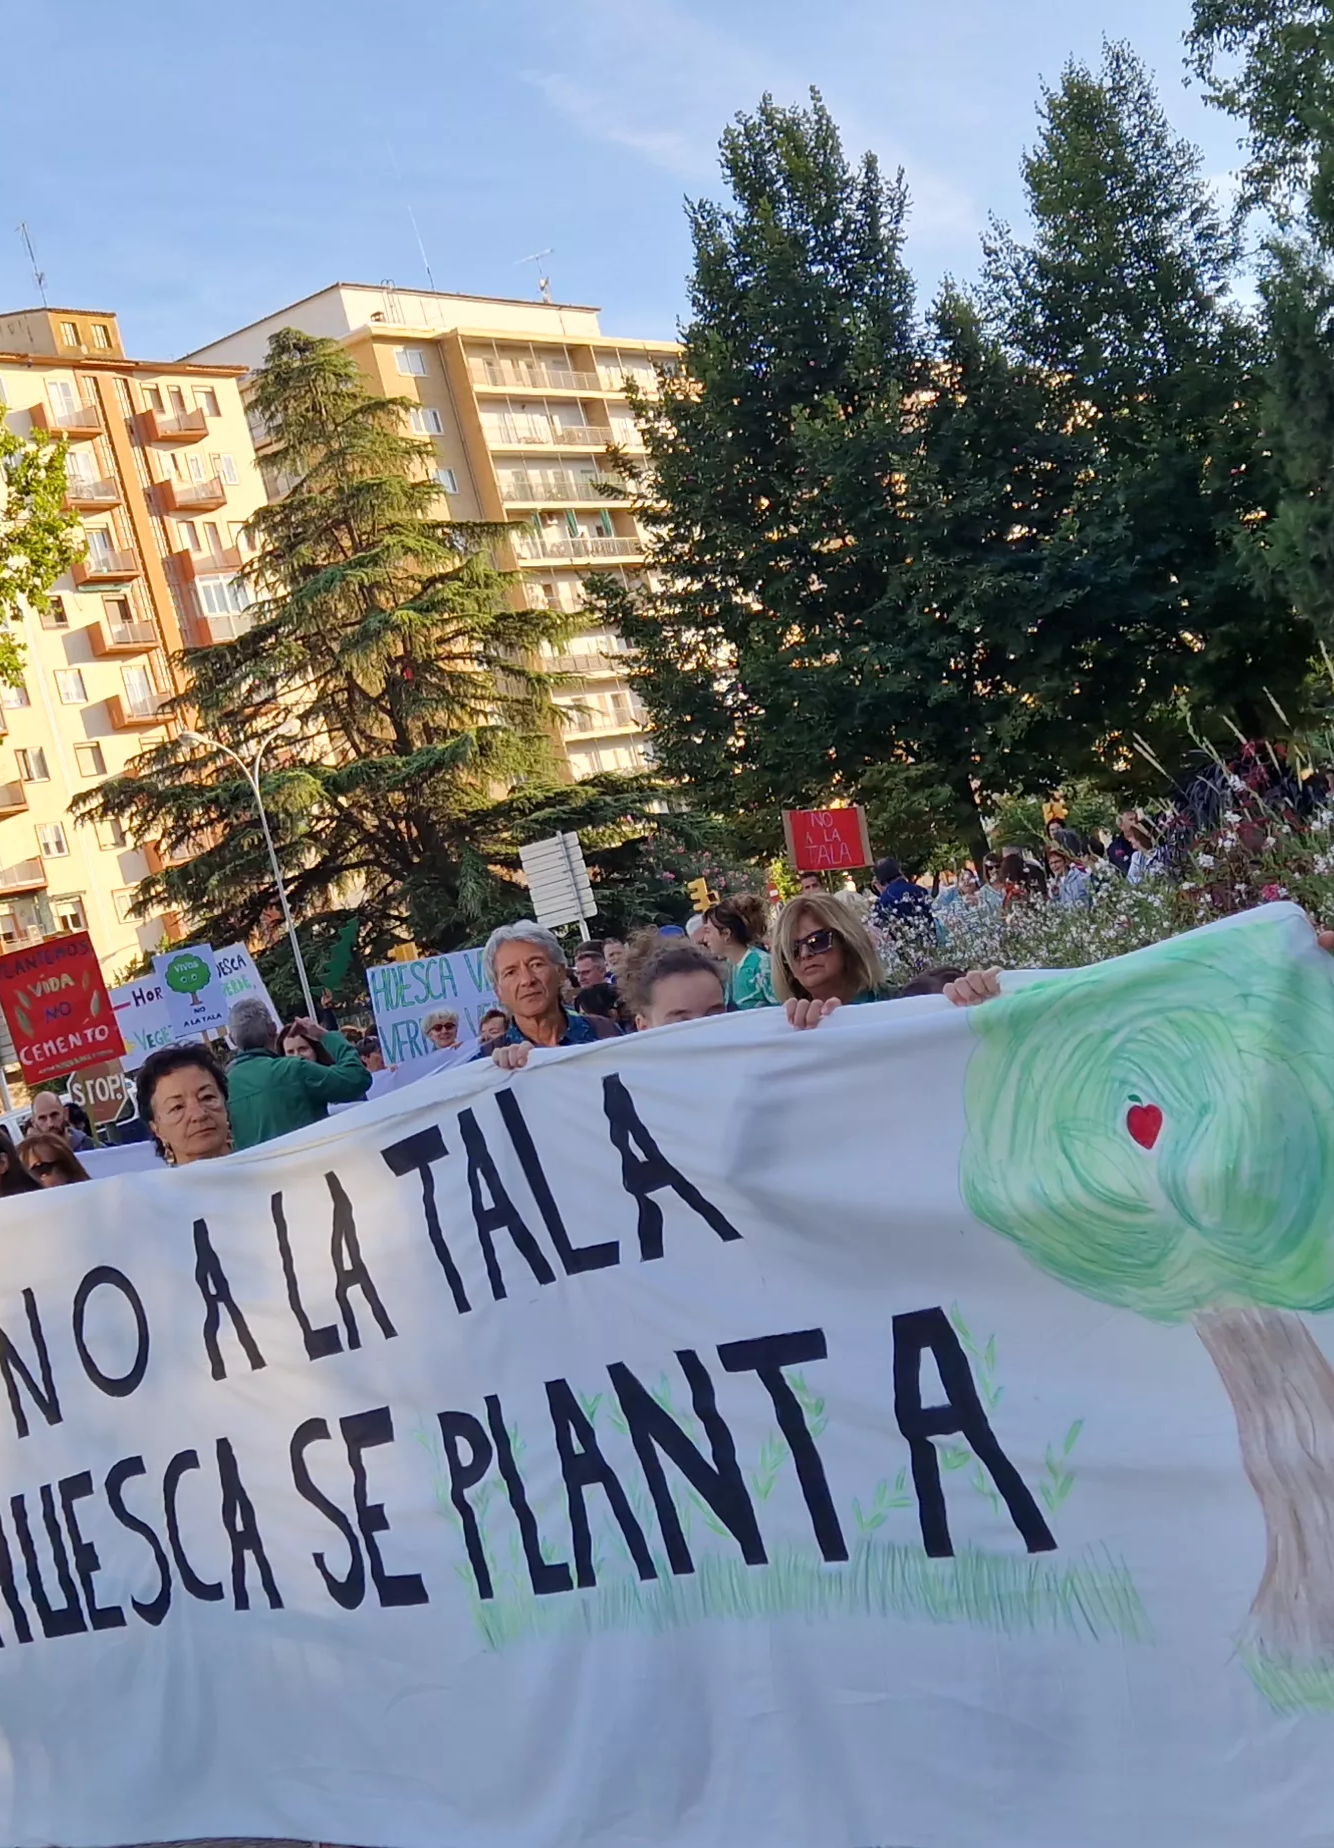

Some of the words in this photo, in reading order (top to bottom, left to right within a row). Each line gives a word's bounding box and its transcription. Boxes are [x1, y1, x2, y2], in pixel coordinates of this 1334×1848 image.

[811, 811, 833, 828] NO
[823, 828, 841, 842] LA
[804, 842, 853, 865] TALA
[371, 956, 458, 1014] HUESCA
[44, 1001, 72, 1024] NO
[183, 1020, 190, 1028] A
[190, 1017, 202, 1026] LA
[202, 1012, 222, 1023] TALA
[194, 1006, 206, 1014] NO
[19, 1024, 109, 1066] CEMENTO
[193, 1218, 267, 1380] A
[271, 1171, 398, 1361] LA
[380, 1072, 743, 1314] TALA
[290, 1405, 429, 1610] SE
